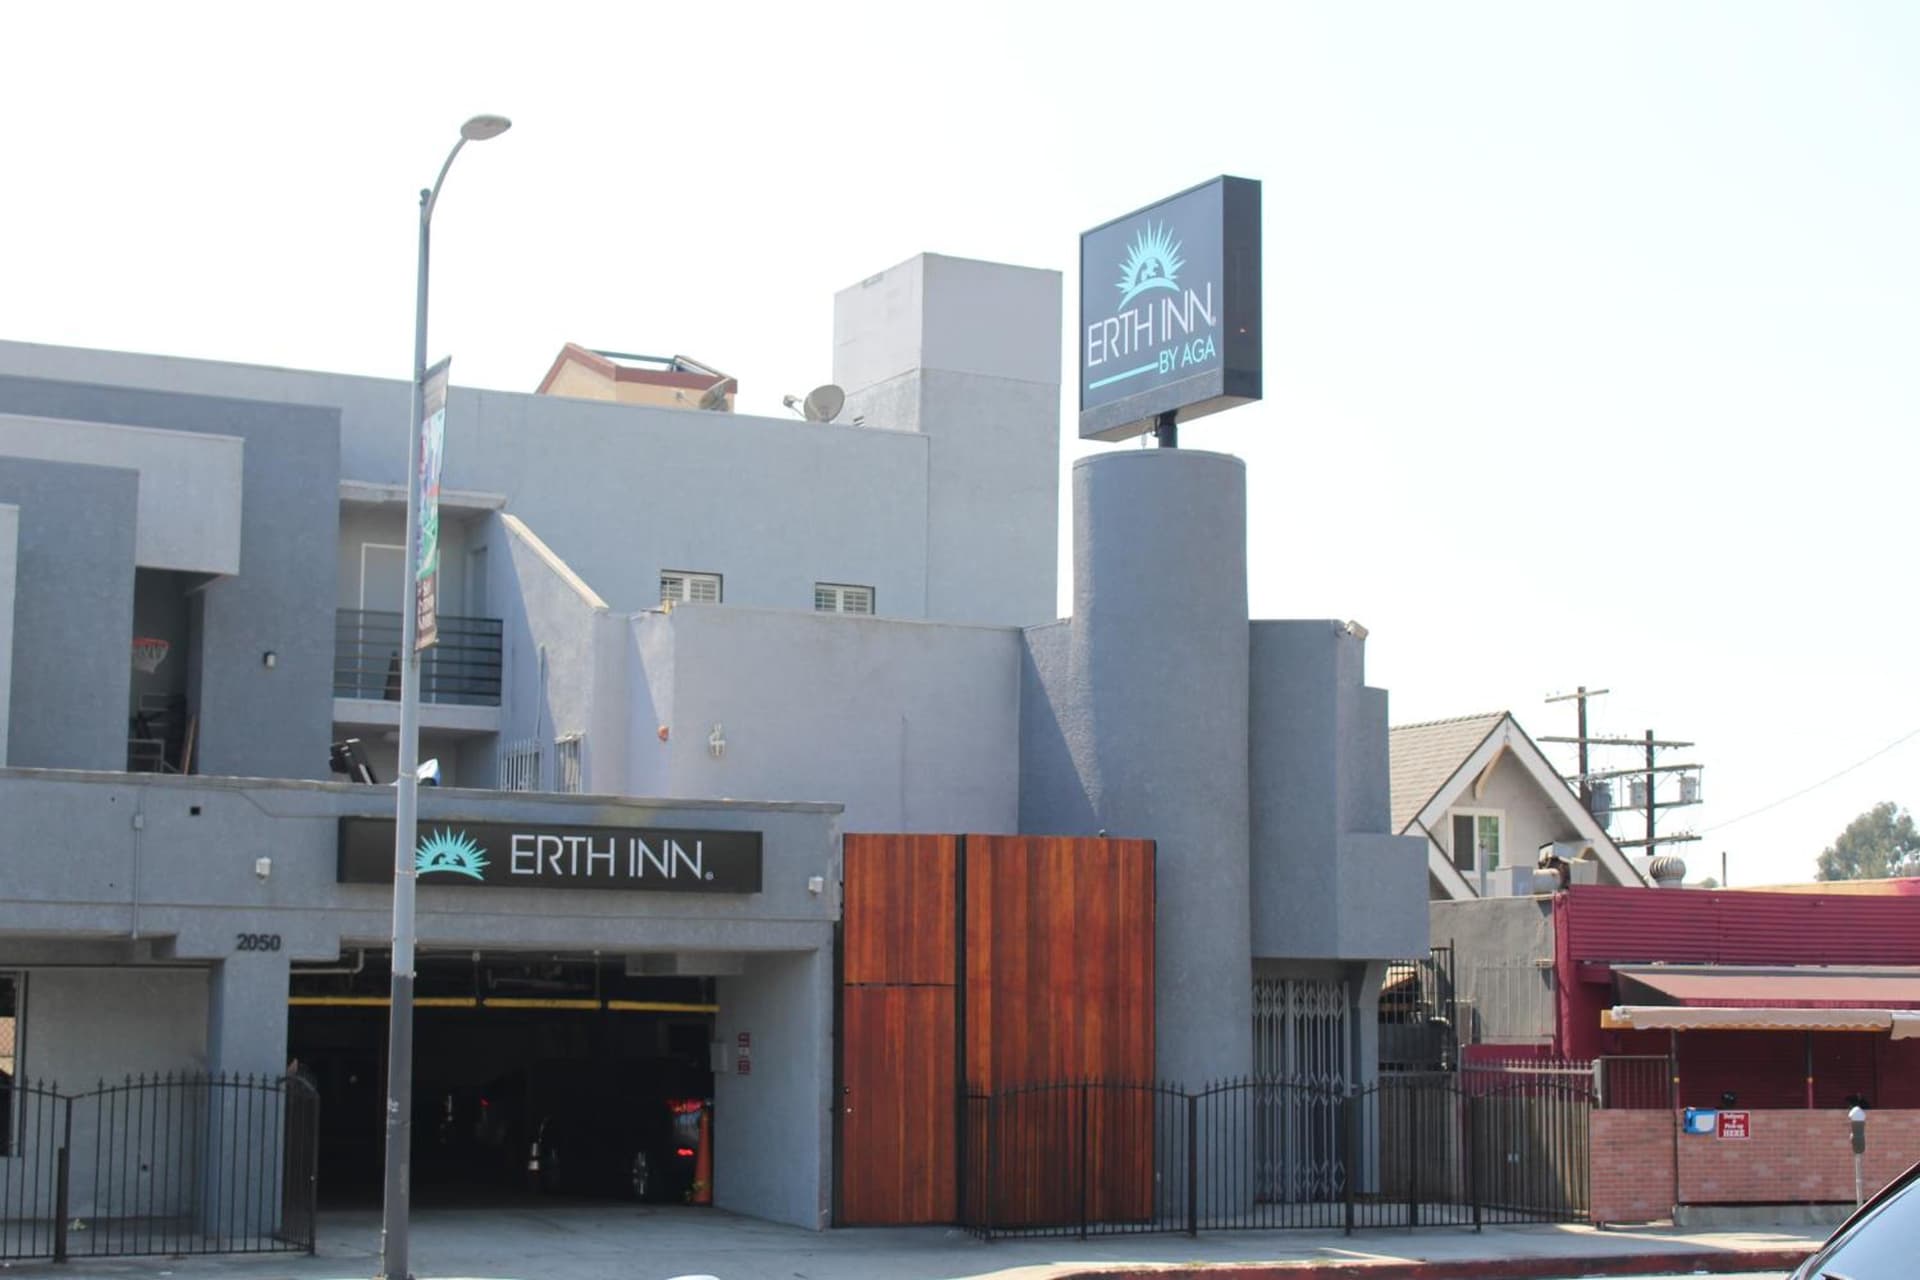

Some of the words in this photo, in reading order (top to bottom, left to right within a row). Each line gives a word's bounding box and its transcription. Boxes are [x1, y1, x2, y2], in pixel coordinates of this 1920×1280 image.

[1088, 304, 1153, 367] ERTH
[1160, 347, 1178, 374] BY
[1181, 336, 1216, 368] AGA
[511, 834, 615, 877] ERTH
[237, 933, 281, 952] 2050
